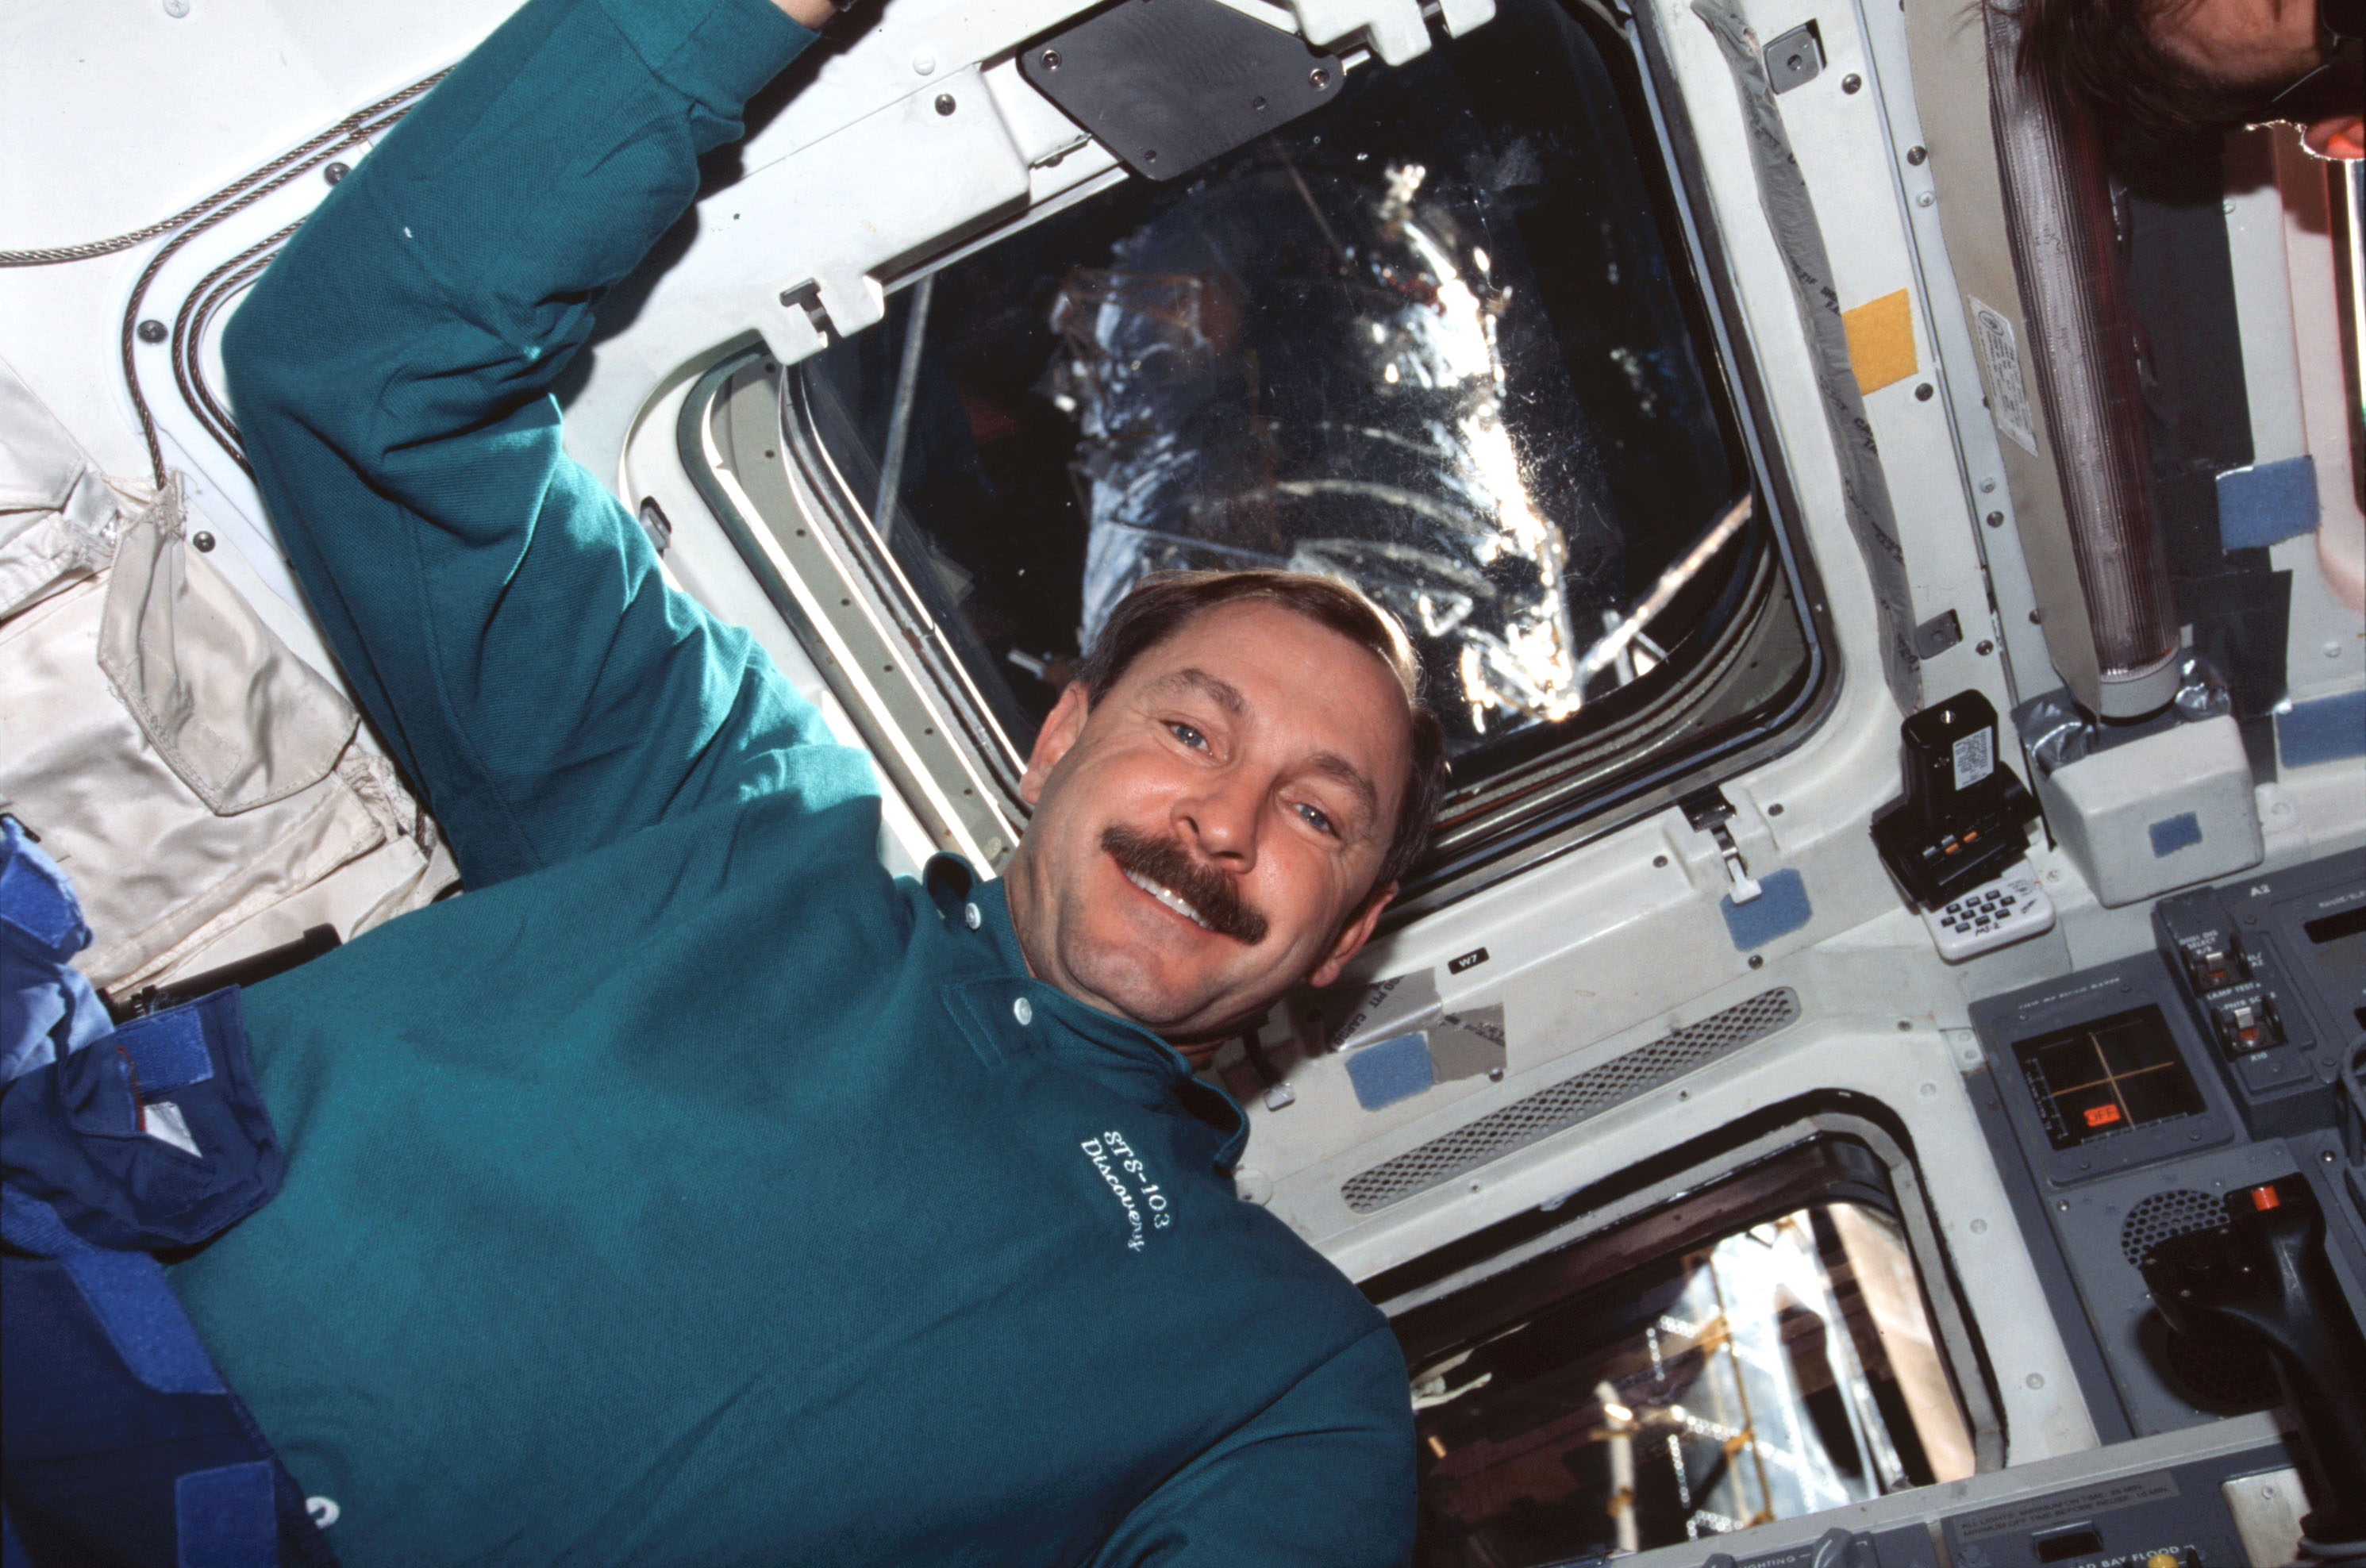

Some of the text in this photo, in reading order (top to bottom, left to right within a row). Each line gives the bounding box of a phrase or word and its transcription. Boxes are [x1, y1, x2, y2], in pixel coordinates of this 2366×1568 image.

[2251, 884, 2270, 897] A2
[2187, 936, 2216, 951] SELECT
[1459, 954, 1478, 968] W7
[2206, 982, 2254, 1001] LAMP TEST
[2088, 1107, 2118, 1123] OFF
[1104, 1131, 1170, 1228] STS-103
[1081, 1137, 1145, 1252] Discovery
[2101, 1546, 2179, 1568] BAY FLOOD
